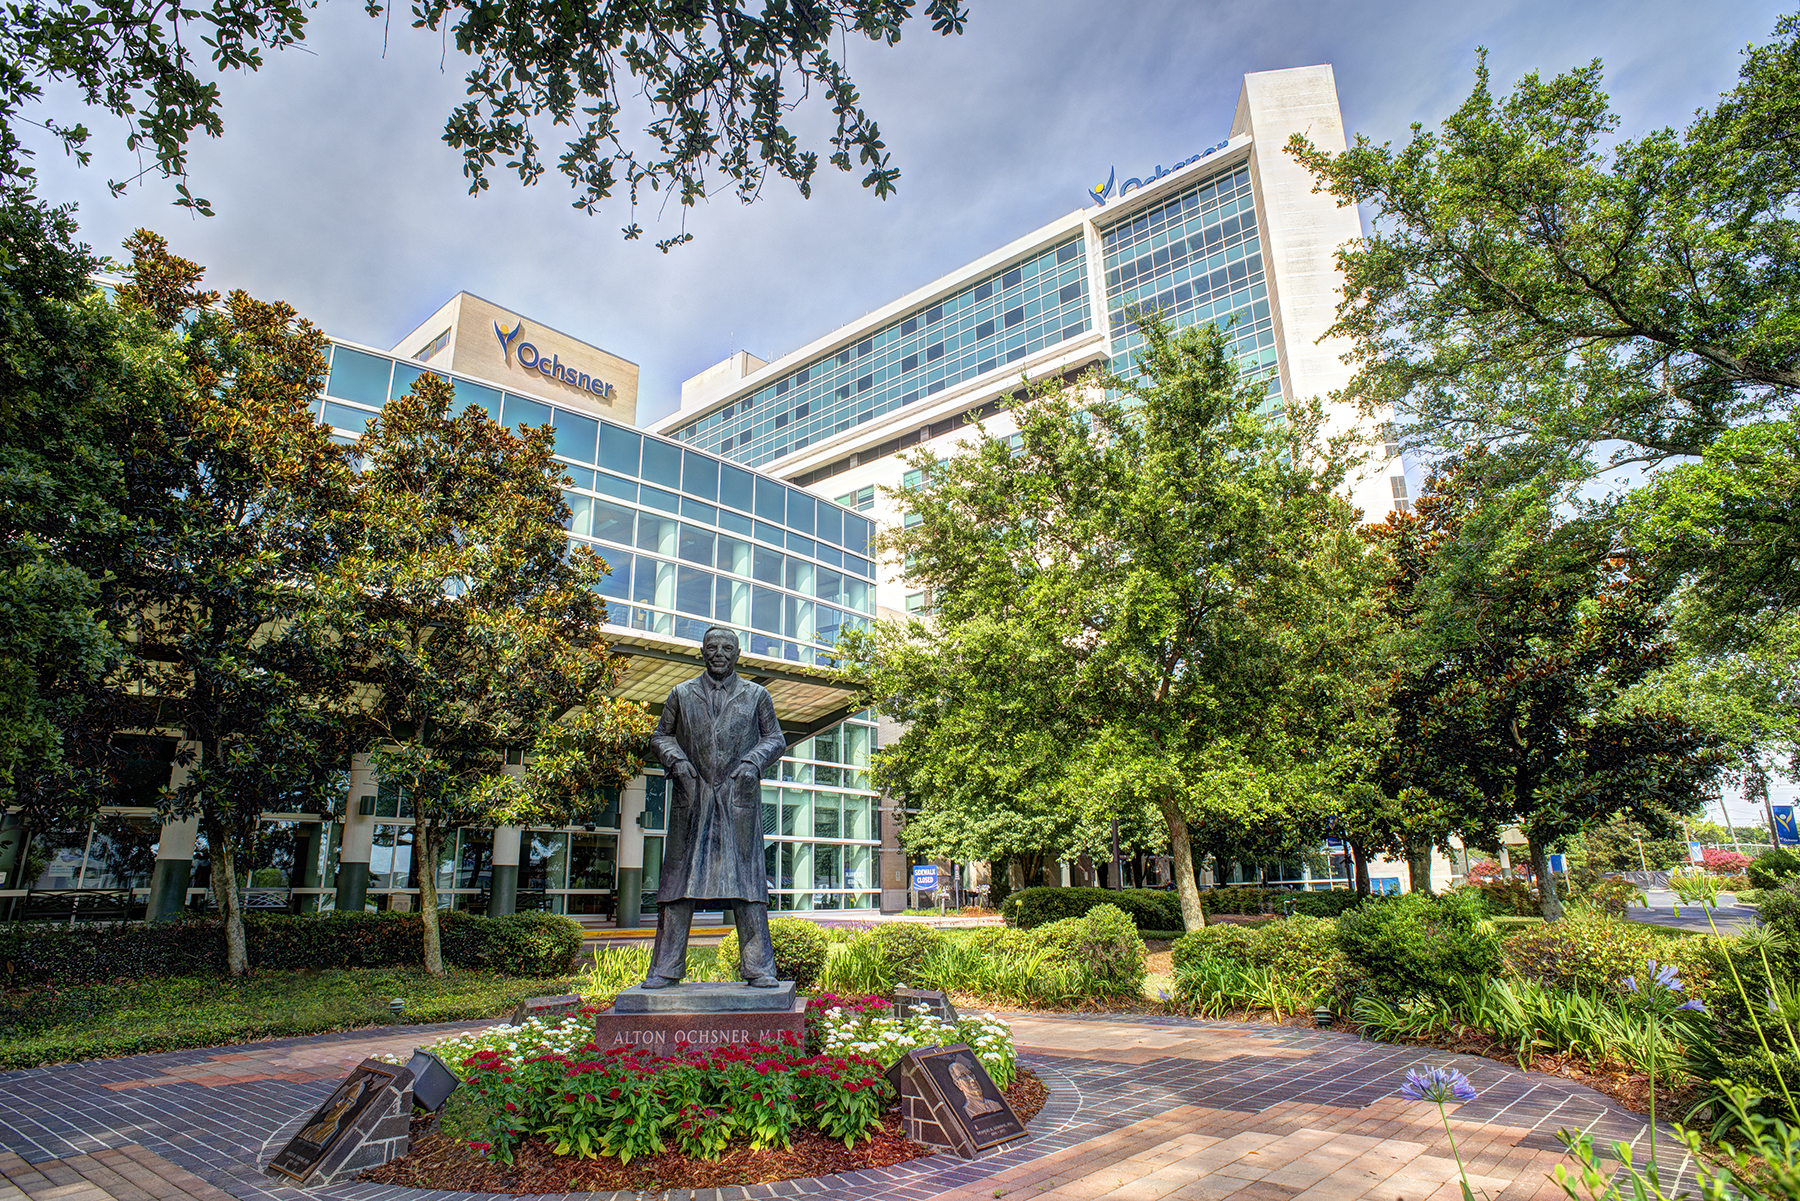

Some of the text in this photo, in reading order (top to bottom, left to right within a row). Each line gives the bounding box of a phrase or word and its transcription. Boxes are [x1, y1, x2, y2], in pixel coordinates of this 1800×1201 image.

[516, 342, 613, 398] Ochsner
[914, 868, 936, 876] SIDEWALK
[916, 876, 934, 884] CLOSED
[613, 1030, 666, 1045] ALTON
[674, 1029, 750, 1044] OCHSNER
